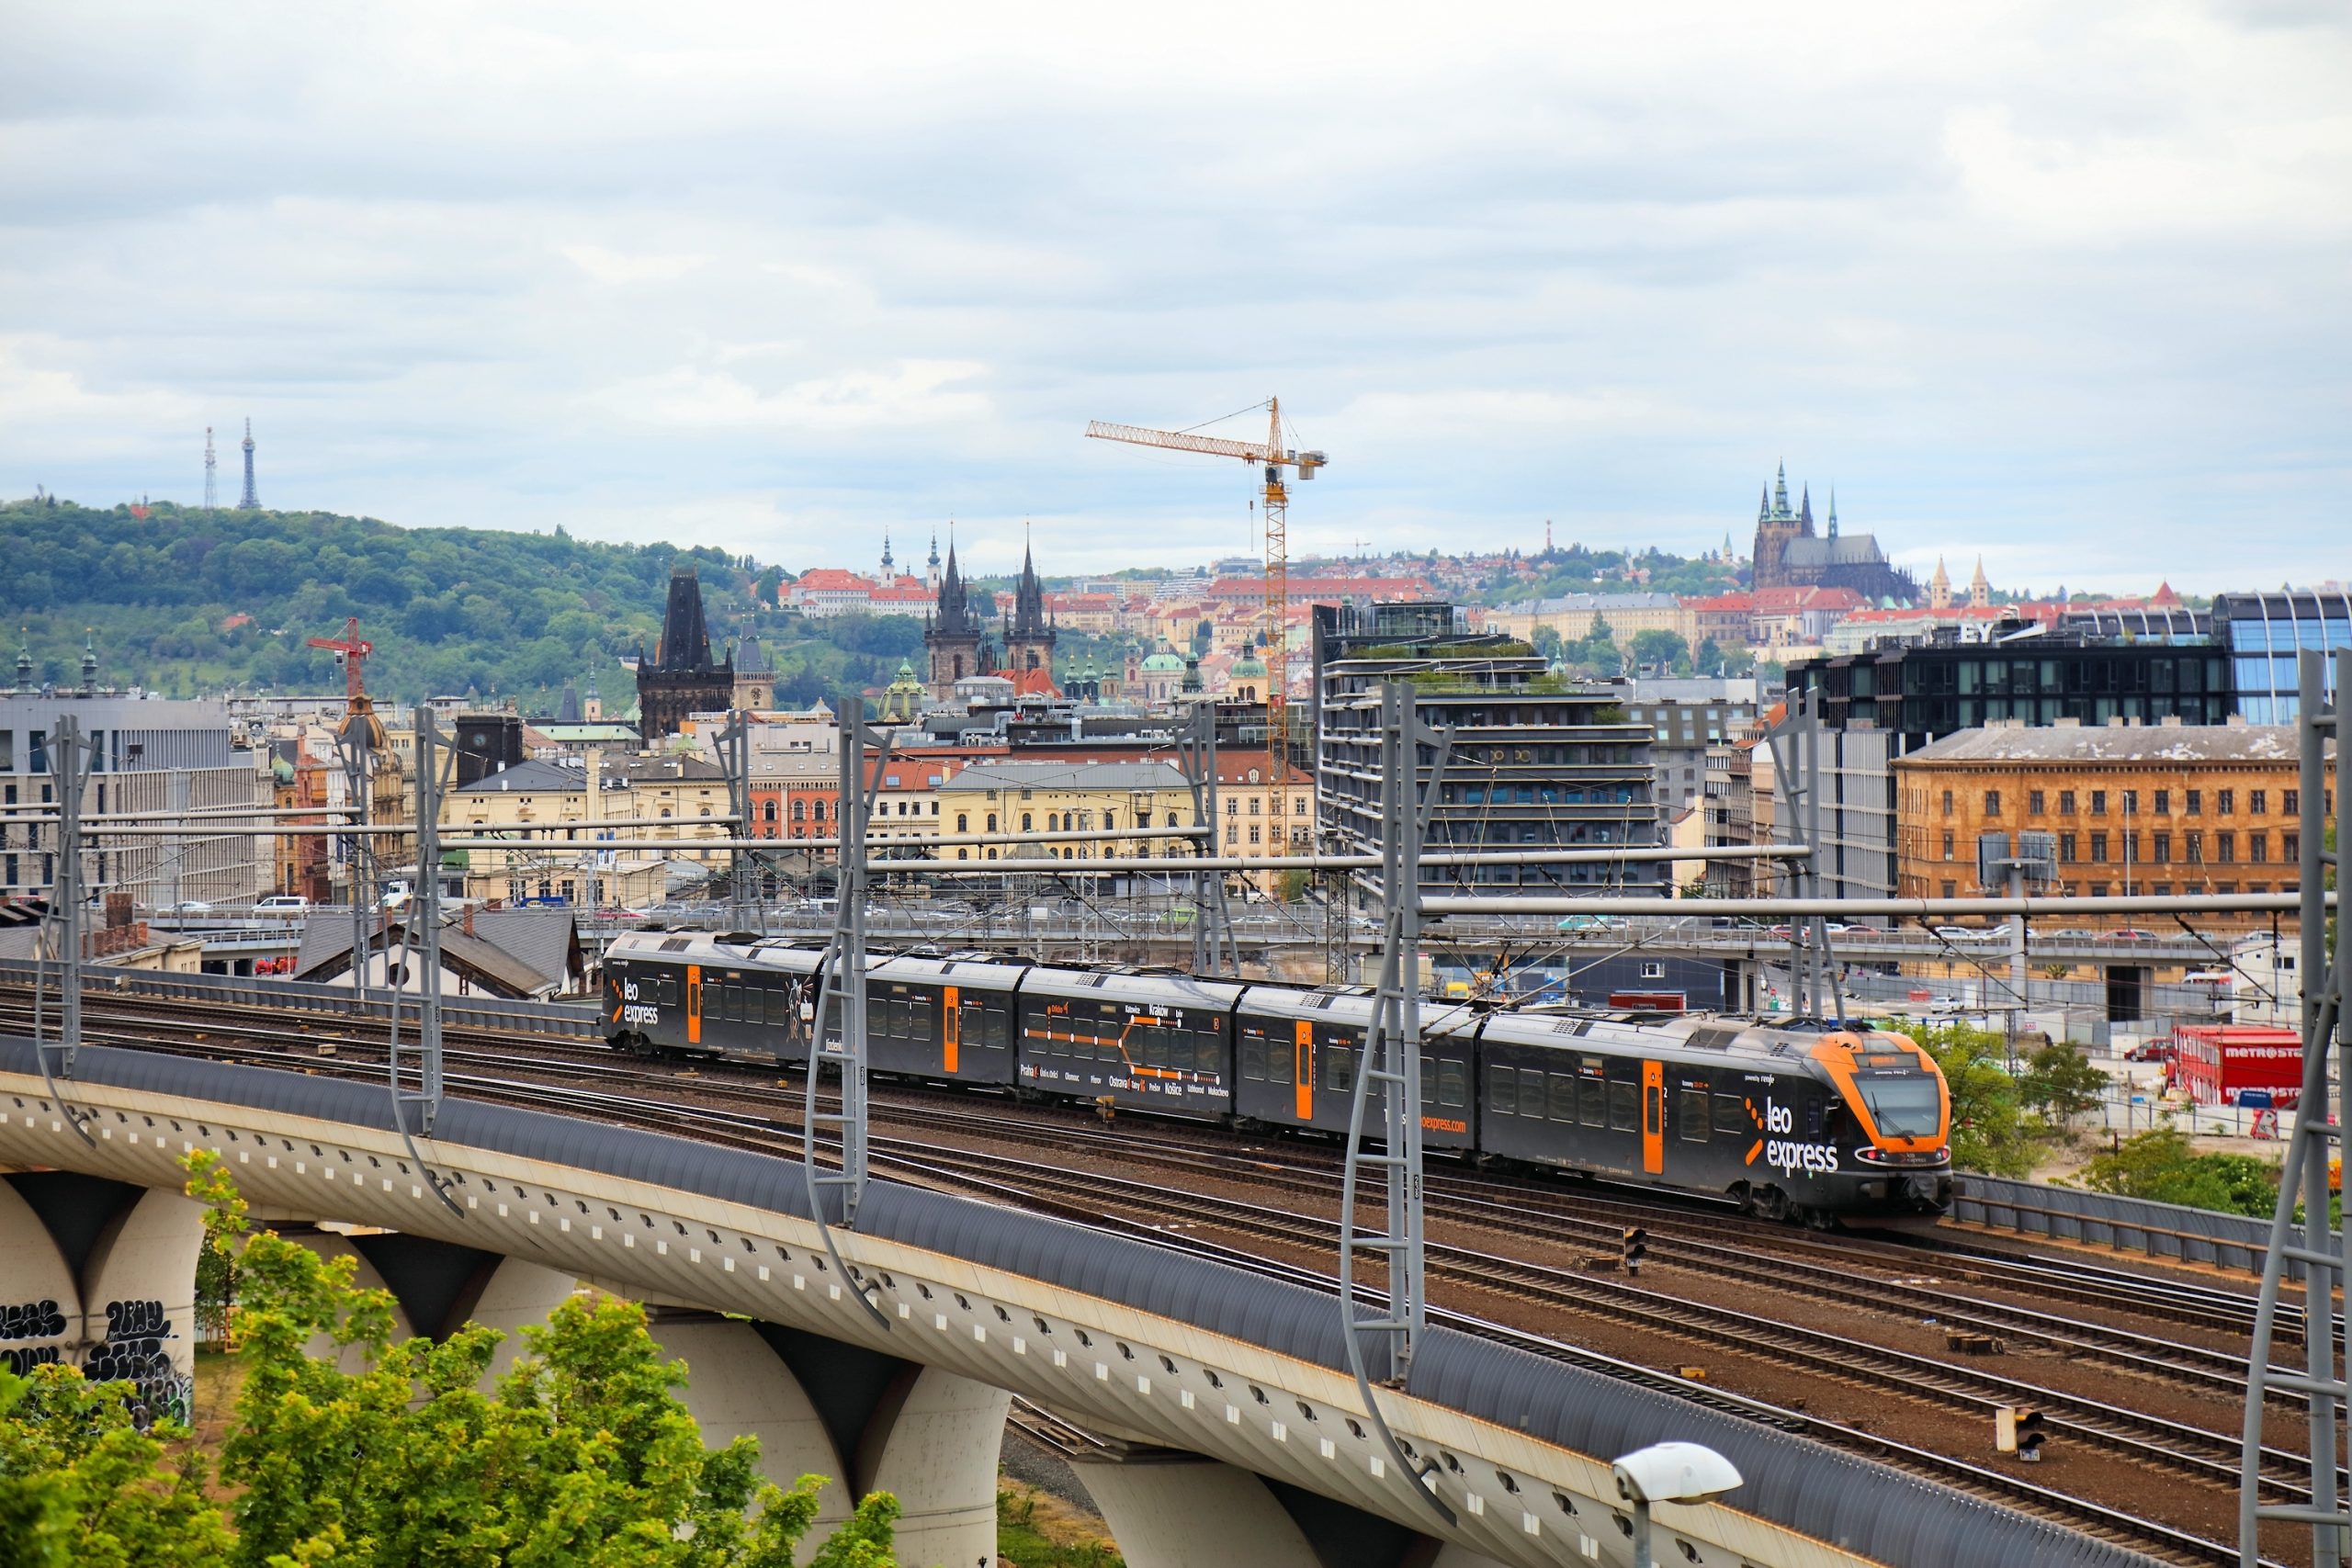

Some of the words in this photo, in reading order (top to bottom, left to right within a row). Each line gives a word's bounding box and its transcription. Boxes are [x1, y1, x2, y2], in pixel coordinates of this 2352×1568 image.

[1960, 622, 1994, 643] EY
[624, 976, 639, 1001] leo
[624, 1003, 658, 1029] express
[1148, 1002, 1169, 1018] Kraków
[1020, 1064, 1034, 1077] Praha
[1108, 1075, 1127, 1089] Ostrava
[1164, 1081, 1182, 1097] Košice
[1767, 1096, 1792, 1134] leo
[1767, 1138, 1838, 1179] express
